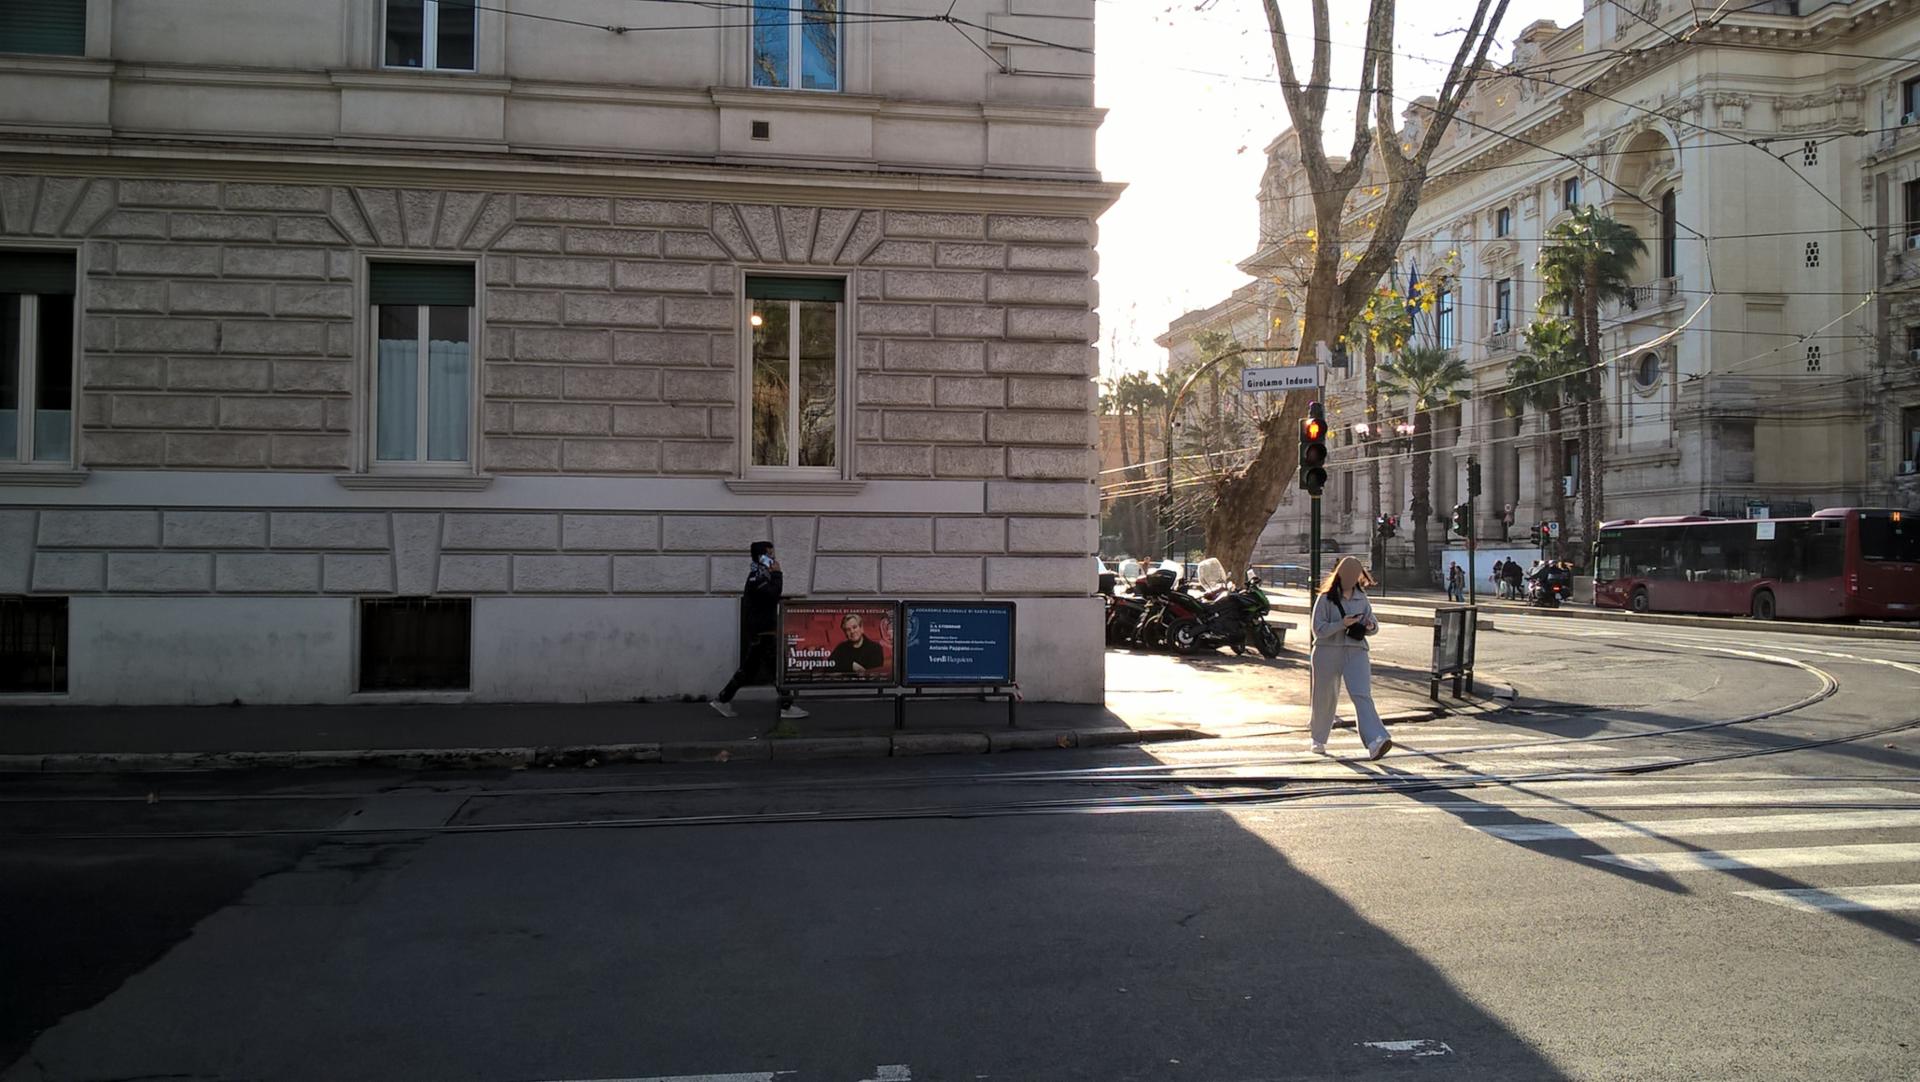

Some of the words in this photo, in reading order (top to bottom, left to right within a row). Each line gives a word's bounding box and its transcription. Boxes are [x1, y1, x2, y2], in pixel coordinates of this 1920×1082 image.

[1247, 379, 1283, 388] Girolamo
[1893, 511, 1901, 521] H
[788, 647, 831, 657] Antonio
[788, 658, 836, 670] Pappano
